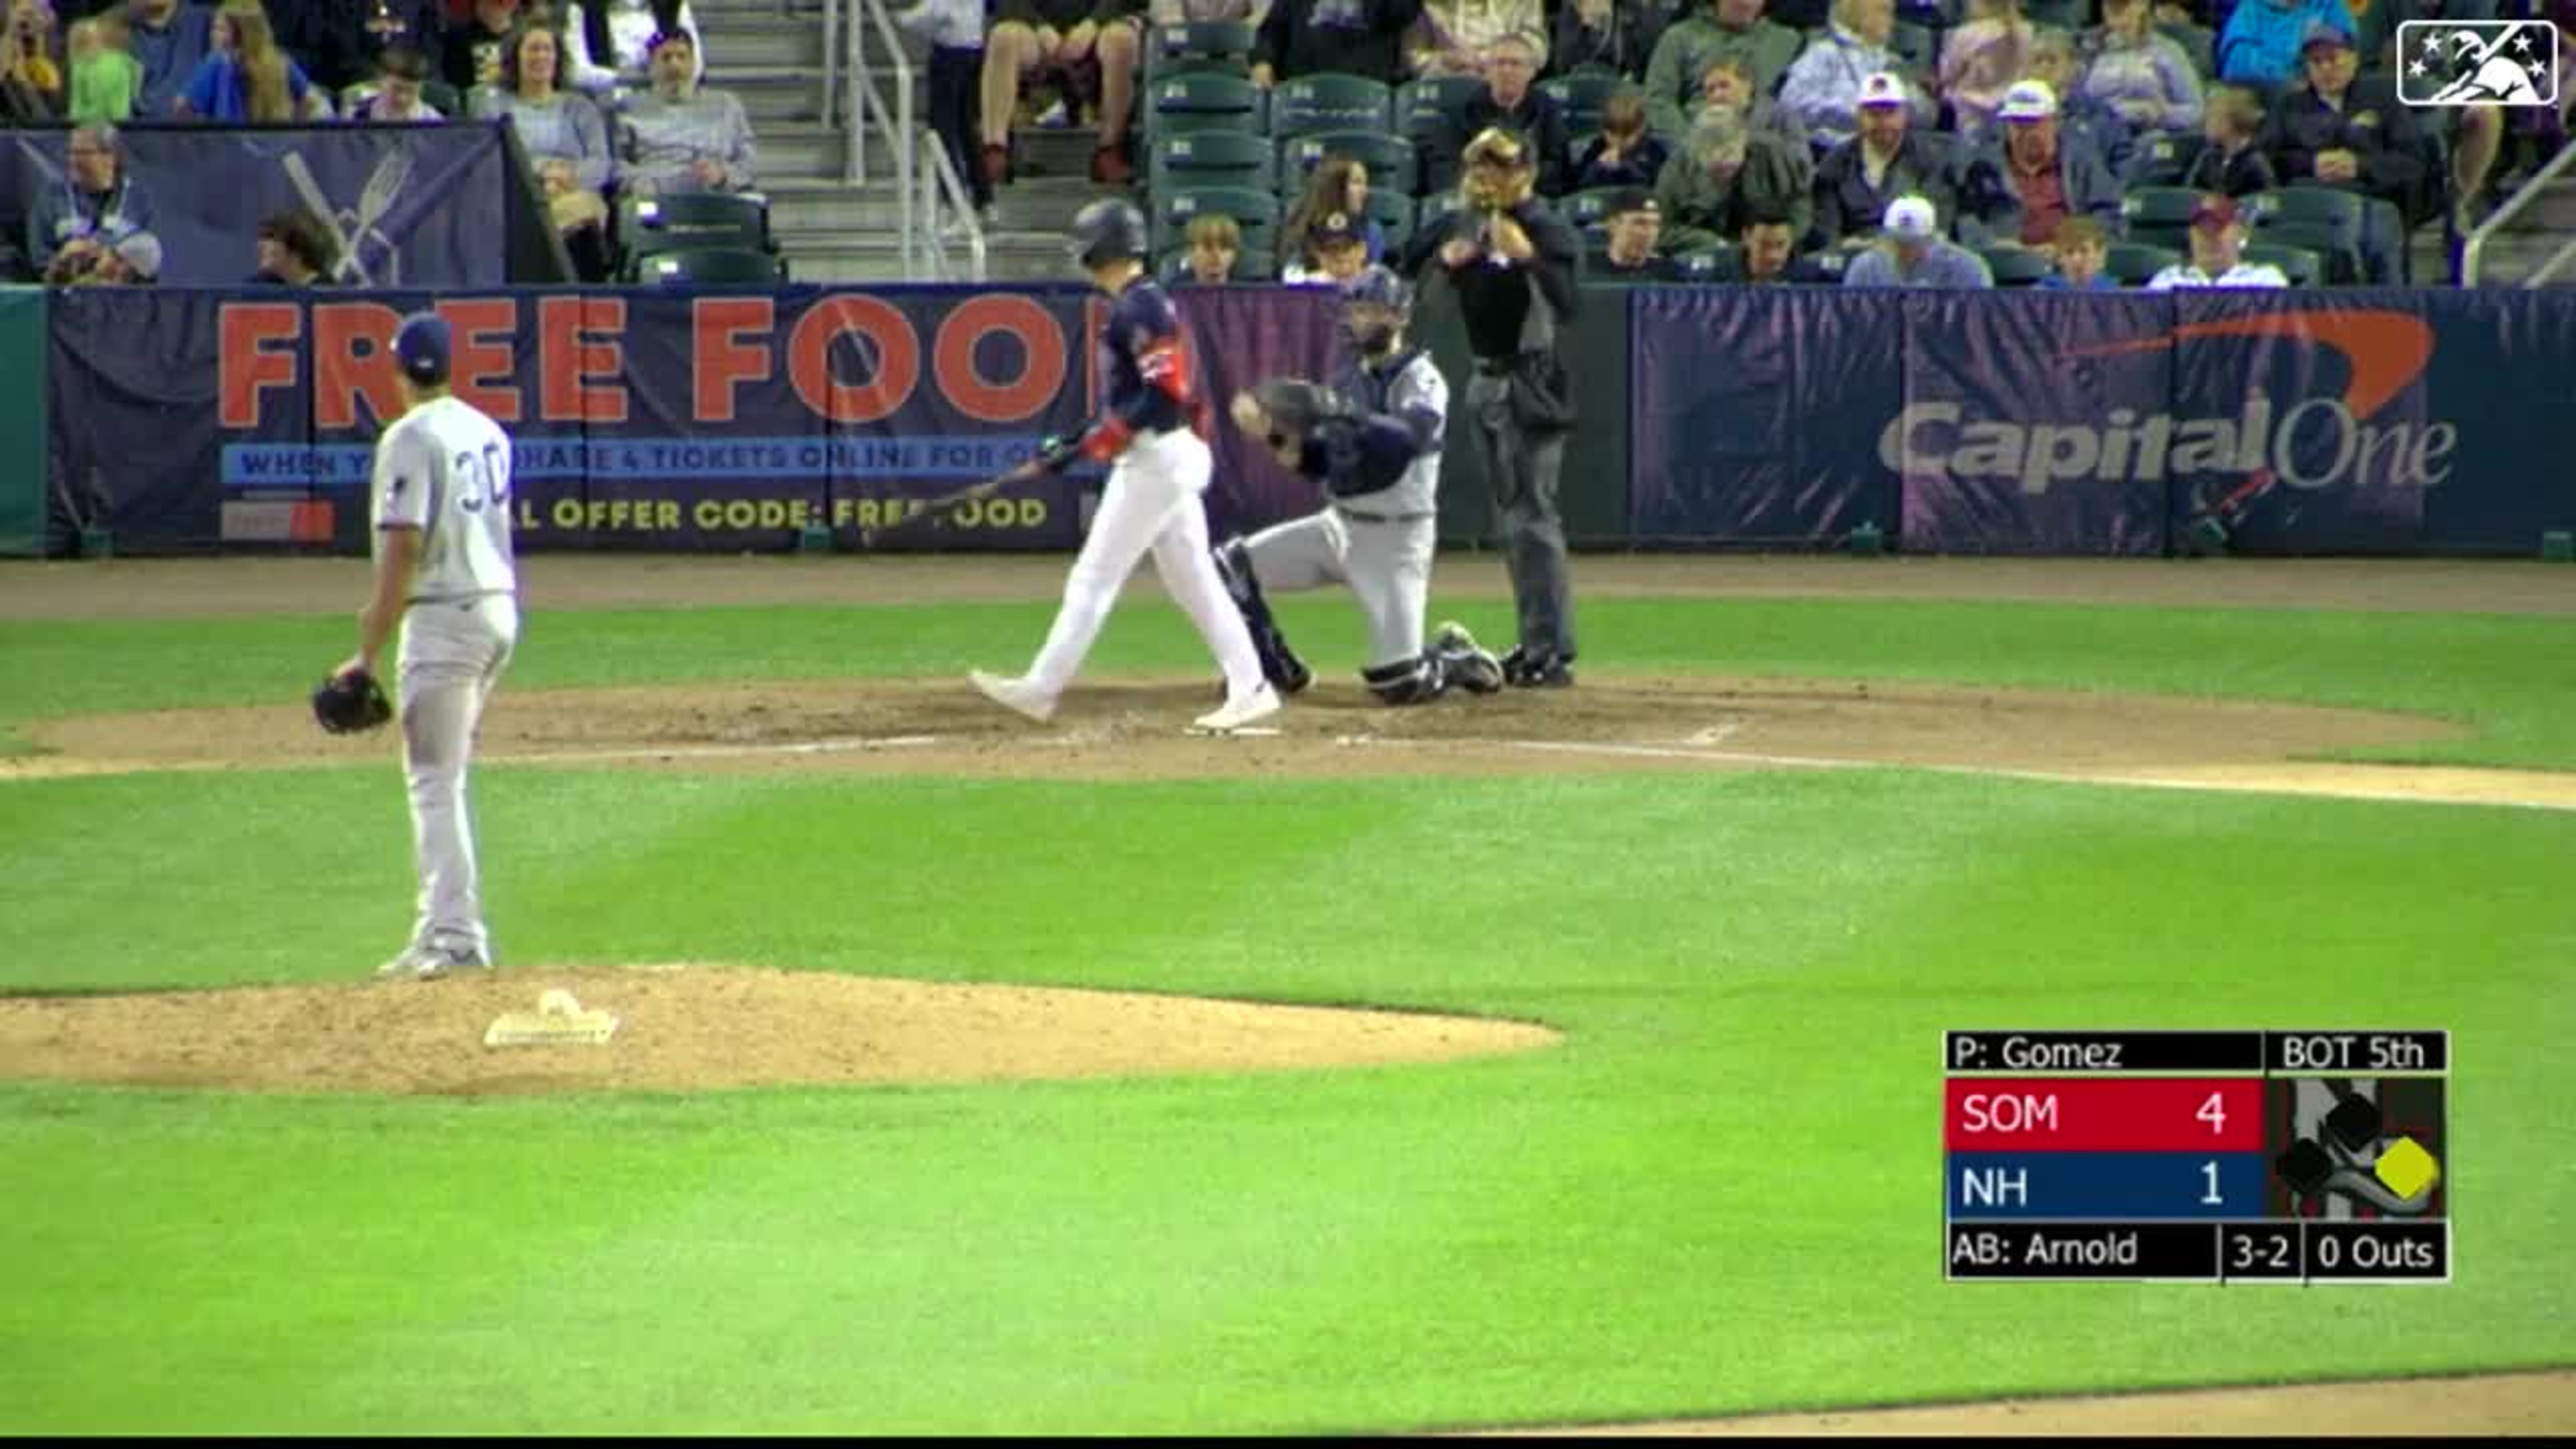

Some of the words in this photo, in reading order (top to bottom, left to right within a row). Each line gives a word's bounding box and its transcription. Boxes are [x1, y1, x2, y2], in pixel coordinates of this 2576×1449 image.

[218, 296, 629, 428] FREE
[692, 293, 1098, 423] FOO
[455, 442, 511, 512] 30
[653, 446, 787, 469] TICKETS
[552, 498, 681, 528] OFFER
[834, 499, 1048, 528] FREOOD
